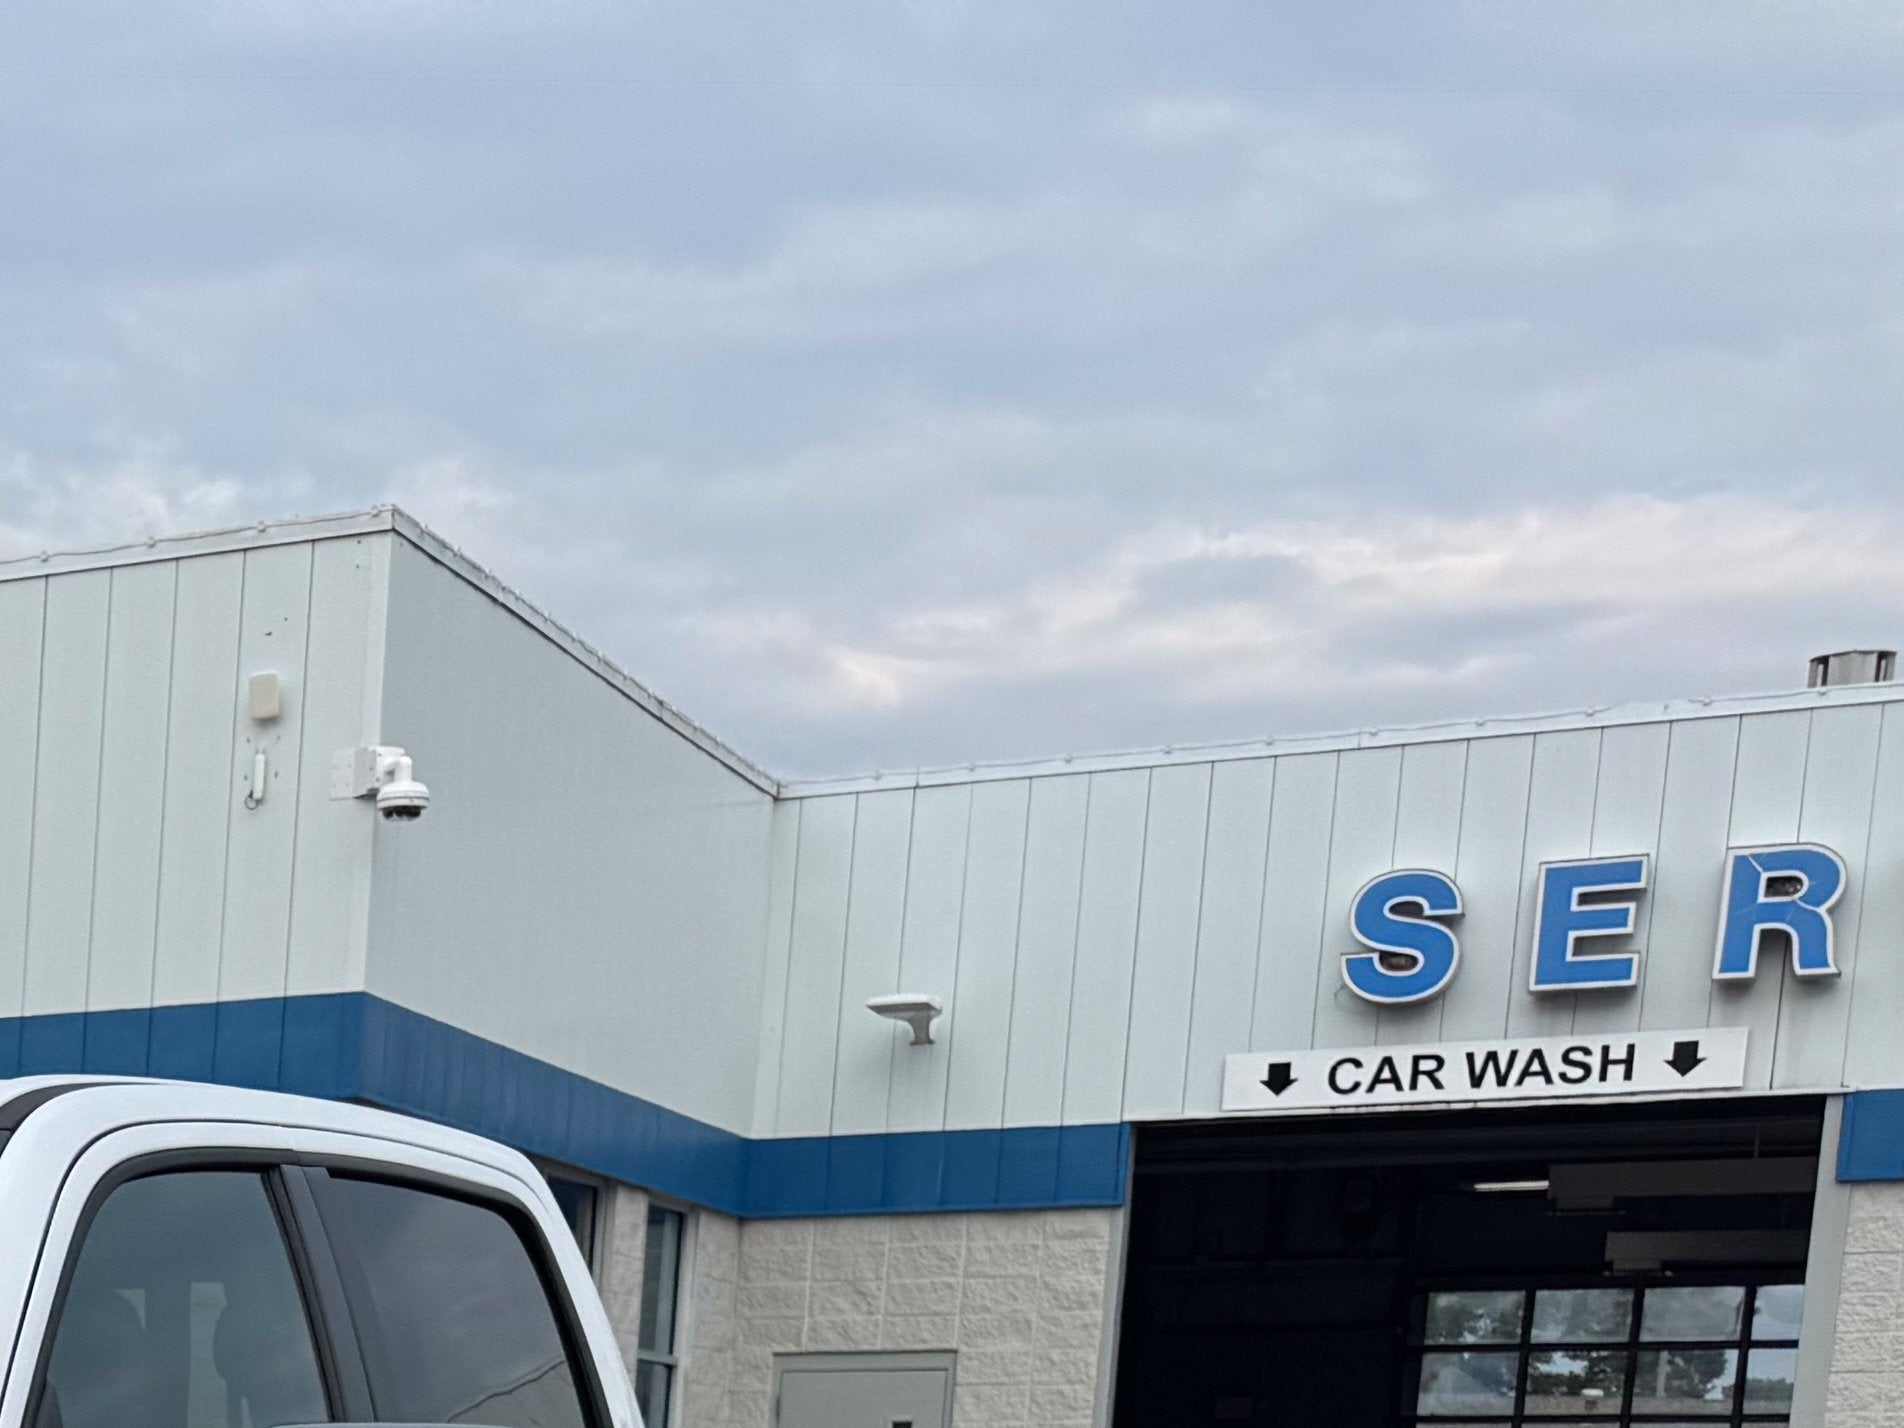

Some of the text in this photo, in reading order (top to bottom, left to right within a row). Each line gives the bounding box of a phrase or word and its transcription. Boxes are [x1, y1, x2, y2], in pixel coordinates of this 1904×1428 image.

[1339, 841, 1848, 1005] SER
[1327, 1043, 1637, 1095] CAR WASH
